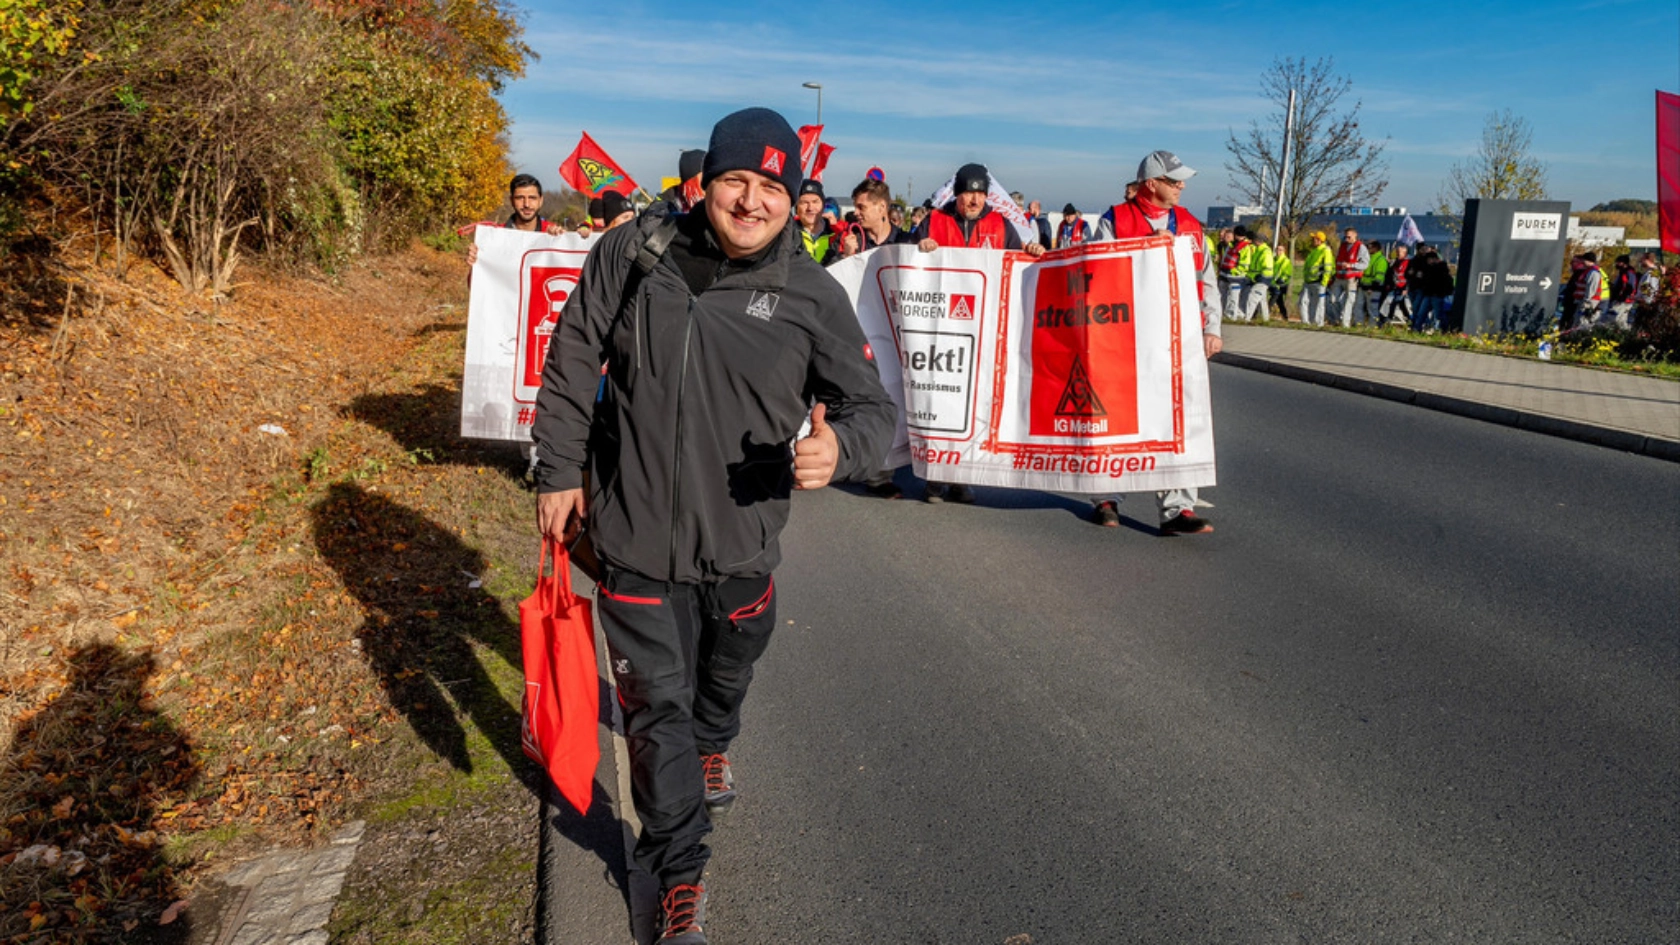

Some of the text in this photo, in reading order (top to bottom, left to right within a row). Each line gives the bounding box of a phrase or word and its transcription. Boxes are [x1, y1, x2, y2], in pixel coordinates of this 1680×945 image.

[1517, 219, 1556, 229] PUREM
[1066, 268, 1093, 296] Wir
[911, 380, 962, 393] Rassismus
[1054, 418, 1108, 434] IG Metall
[1013, 451, 1156, 478] #fairteidigen
